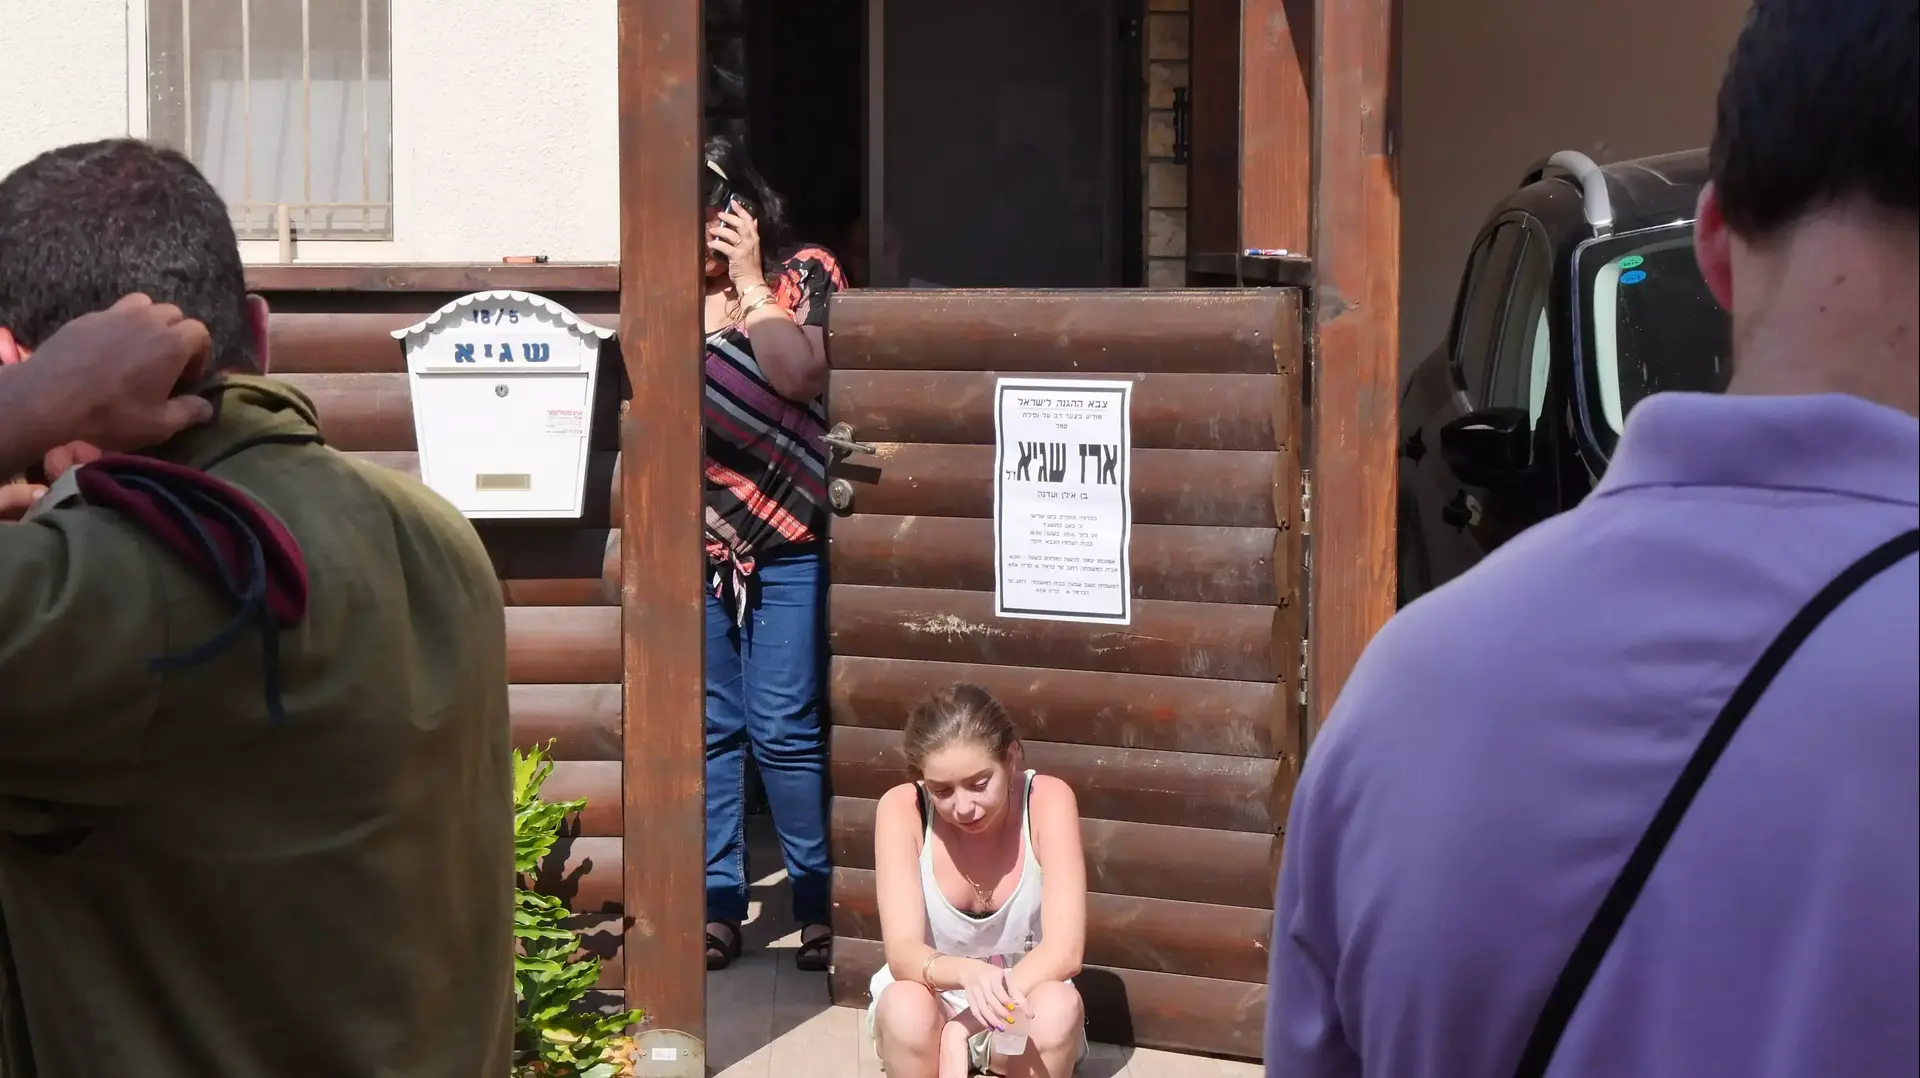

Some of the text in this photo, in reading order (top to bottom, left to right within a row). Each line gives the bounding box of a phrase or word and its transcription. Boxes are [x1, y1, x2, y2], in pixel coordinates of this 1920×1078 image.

[473, 308, 519, 326] 18/5
[454, 343, 550, 363] שגיא
[1018, 398, 1109, 409] צבא ההגנה לישראל
[1016, 441, 1066, 483] שגיא
[1079, 443, 1118, 485] ארז
[1037, 490, 1089, 500] בן אילן ועדנה
